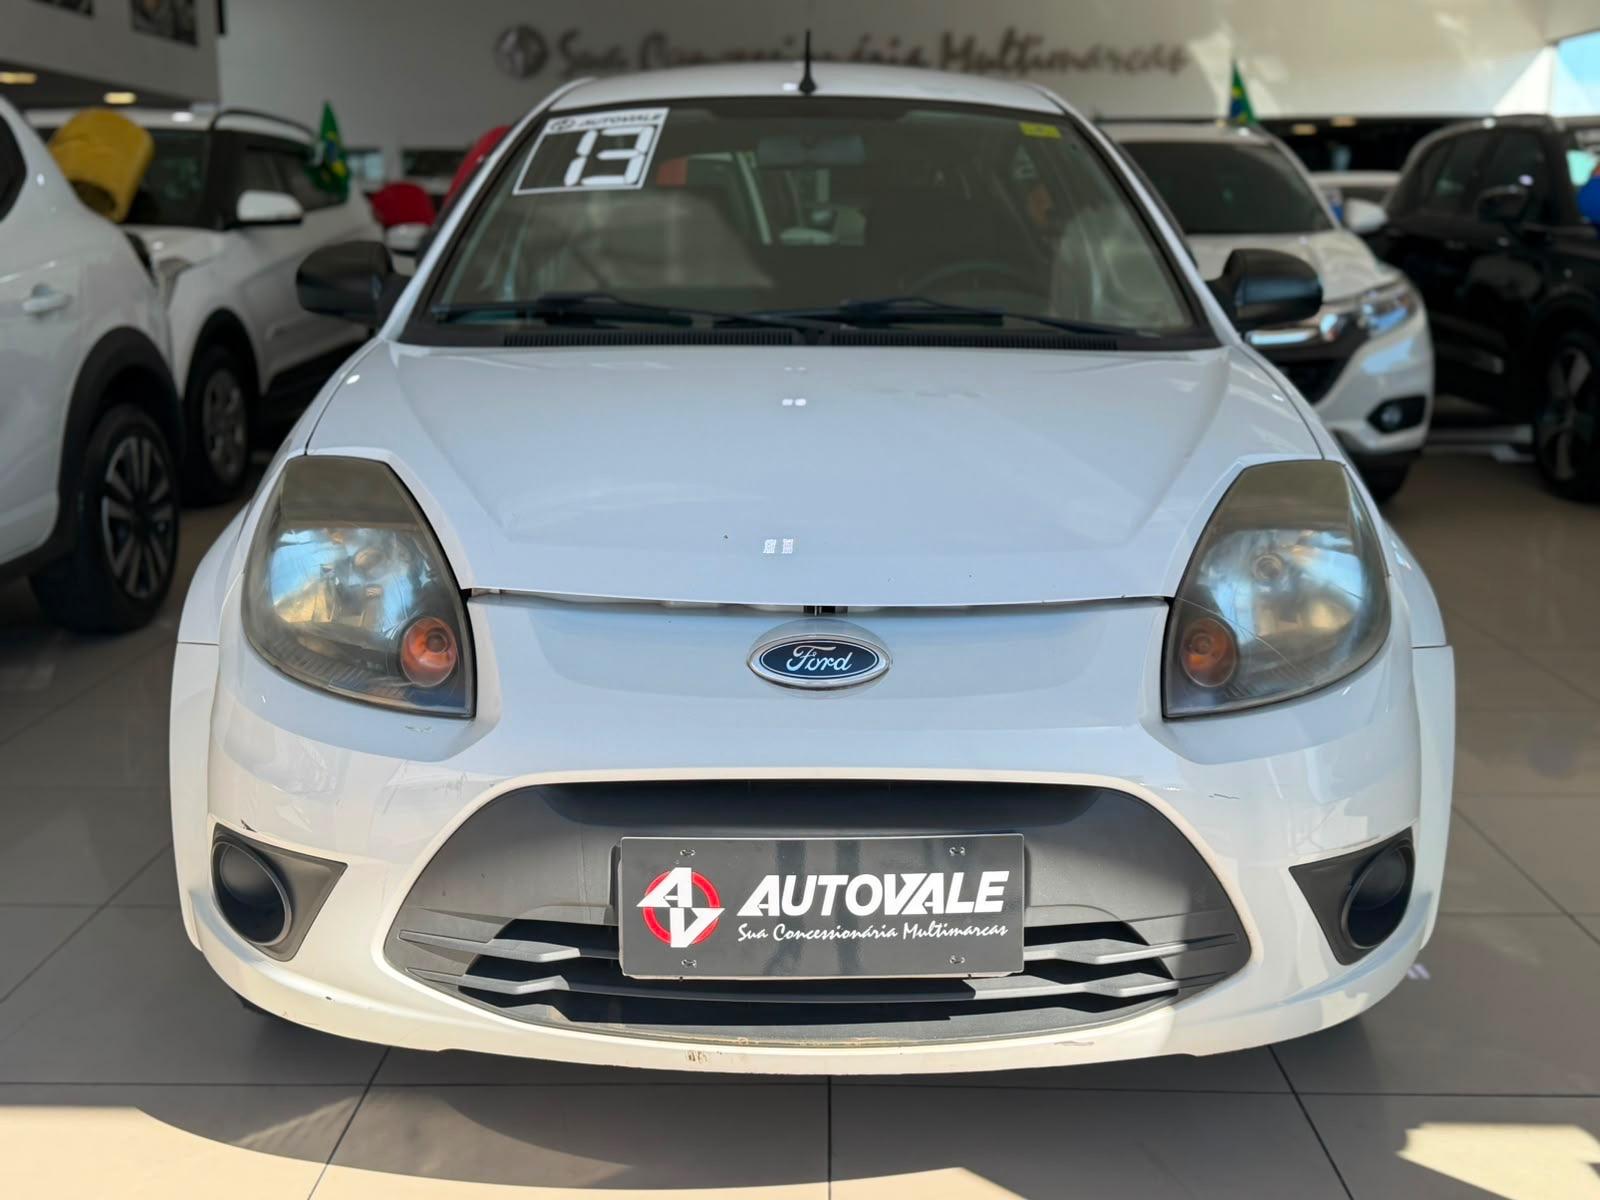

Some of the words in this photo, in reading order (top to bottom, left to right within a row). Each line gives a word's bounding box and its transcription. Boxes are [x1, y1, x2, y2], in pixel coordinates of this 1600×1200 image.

[563, 126, 655, 187] 13
[786, 645, 853, 672] Ford
[736, 871, 1010, 917] AUTOVALE
[738, 923, 768, 942] Sua
[773, 923, 898, 942] Concessionária
[903, 920, 1009, 940] Multimarcas
